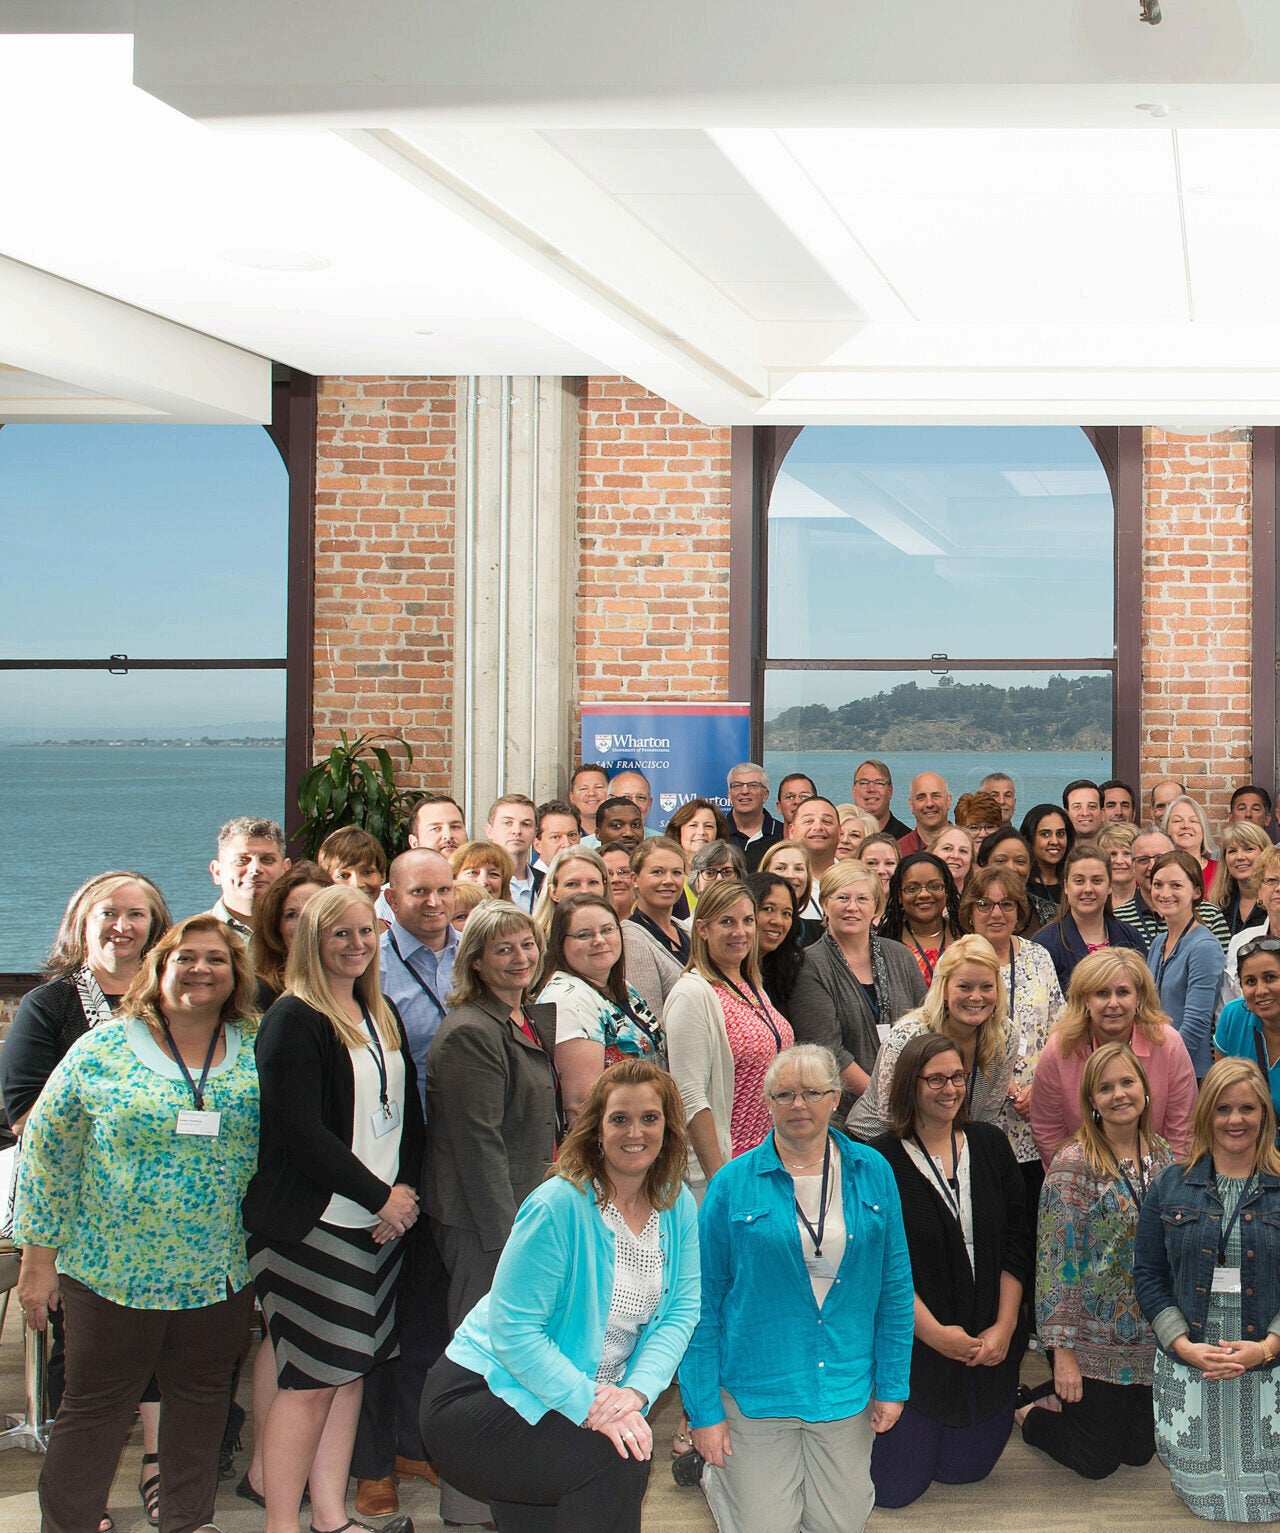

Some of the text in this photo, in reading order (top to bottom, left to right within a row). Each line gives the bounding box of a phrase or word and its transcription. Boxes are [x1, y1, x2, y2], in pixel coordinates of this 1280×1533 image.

[613, 734, 670, 748] Wharton
[595, 760, 670, 768] SAN FRANCISCO
